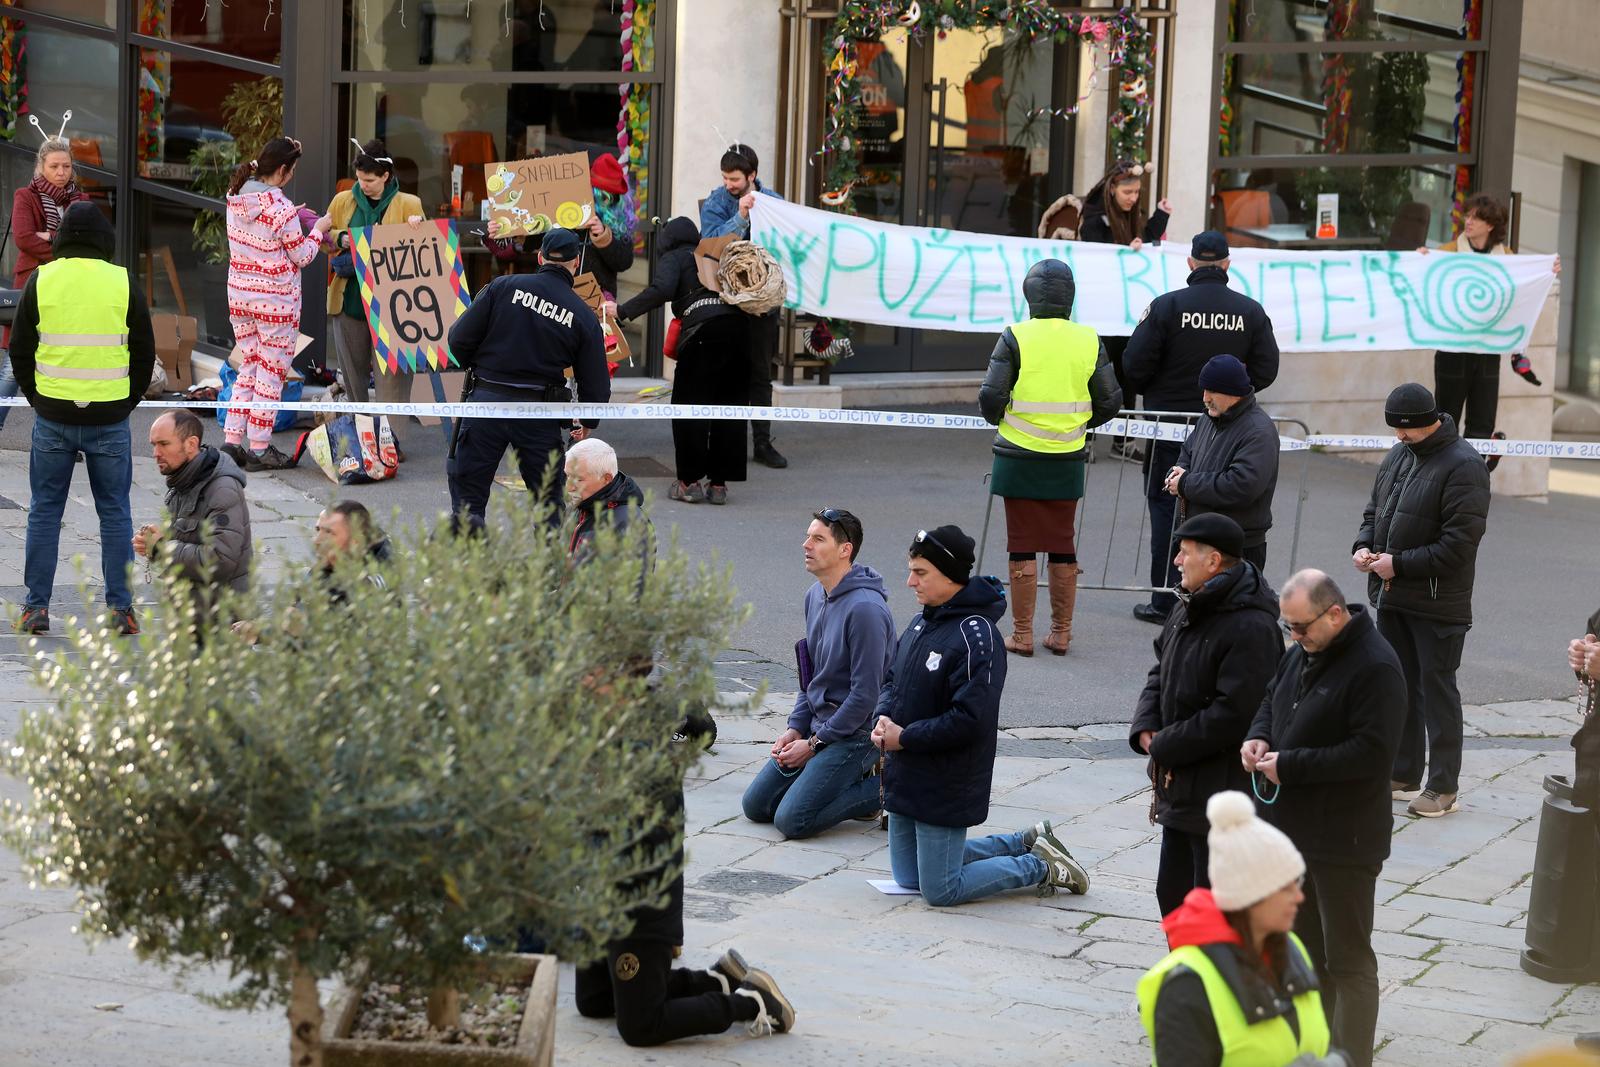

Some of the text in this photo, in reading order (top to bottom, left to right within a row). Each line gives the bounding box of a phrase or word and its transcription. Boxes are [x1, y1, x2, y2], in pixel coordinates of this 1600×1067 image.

[517, 161, 584, 185] SNAILED
[531, 191, 551, 209] IT
[390, 285, 444, 344] 69
[511, 289, 574, 328] POLICIJA
[1181, 312, 1244, 332] POLICIJA
